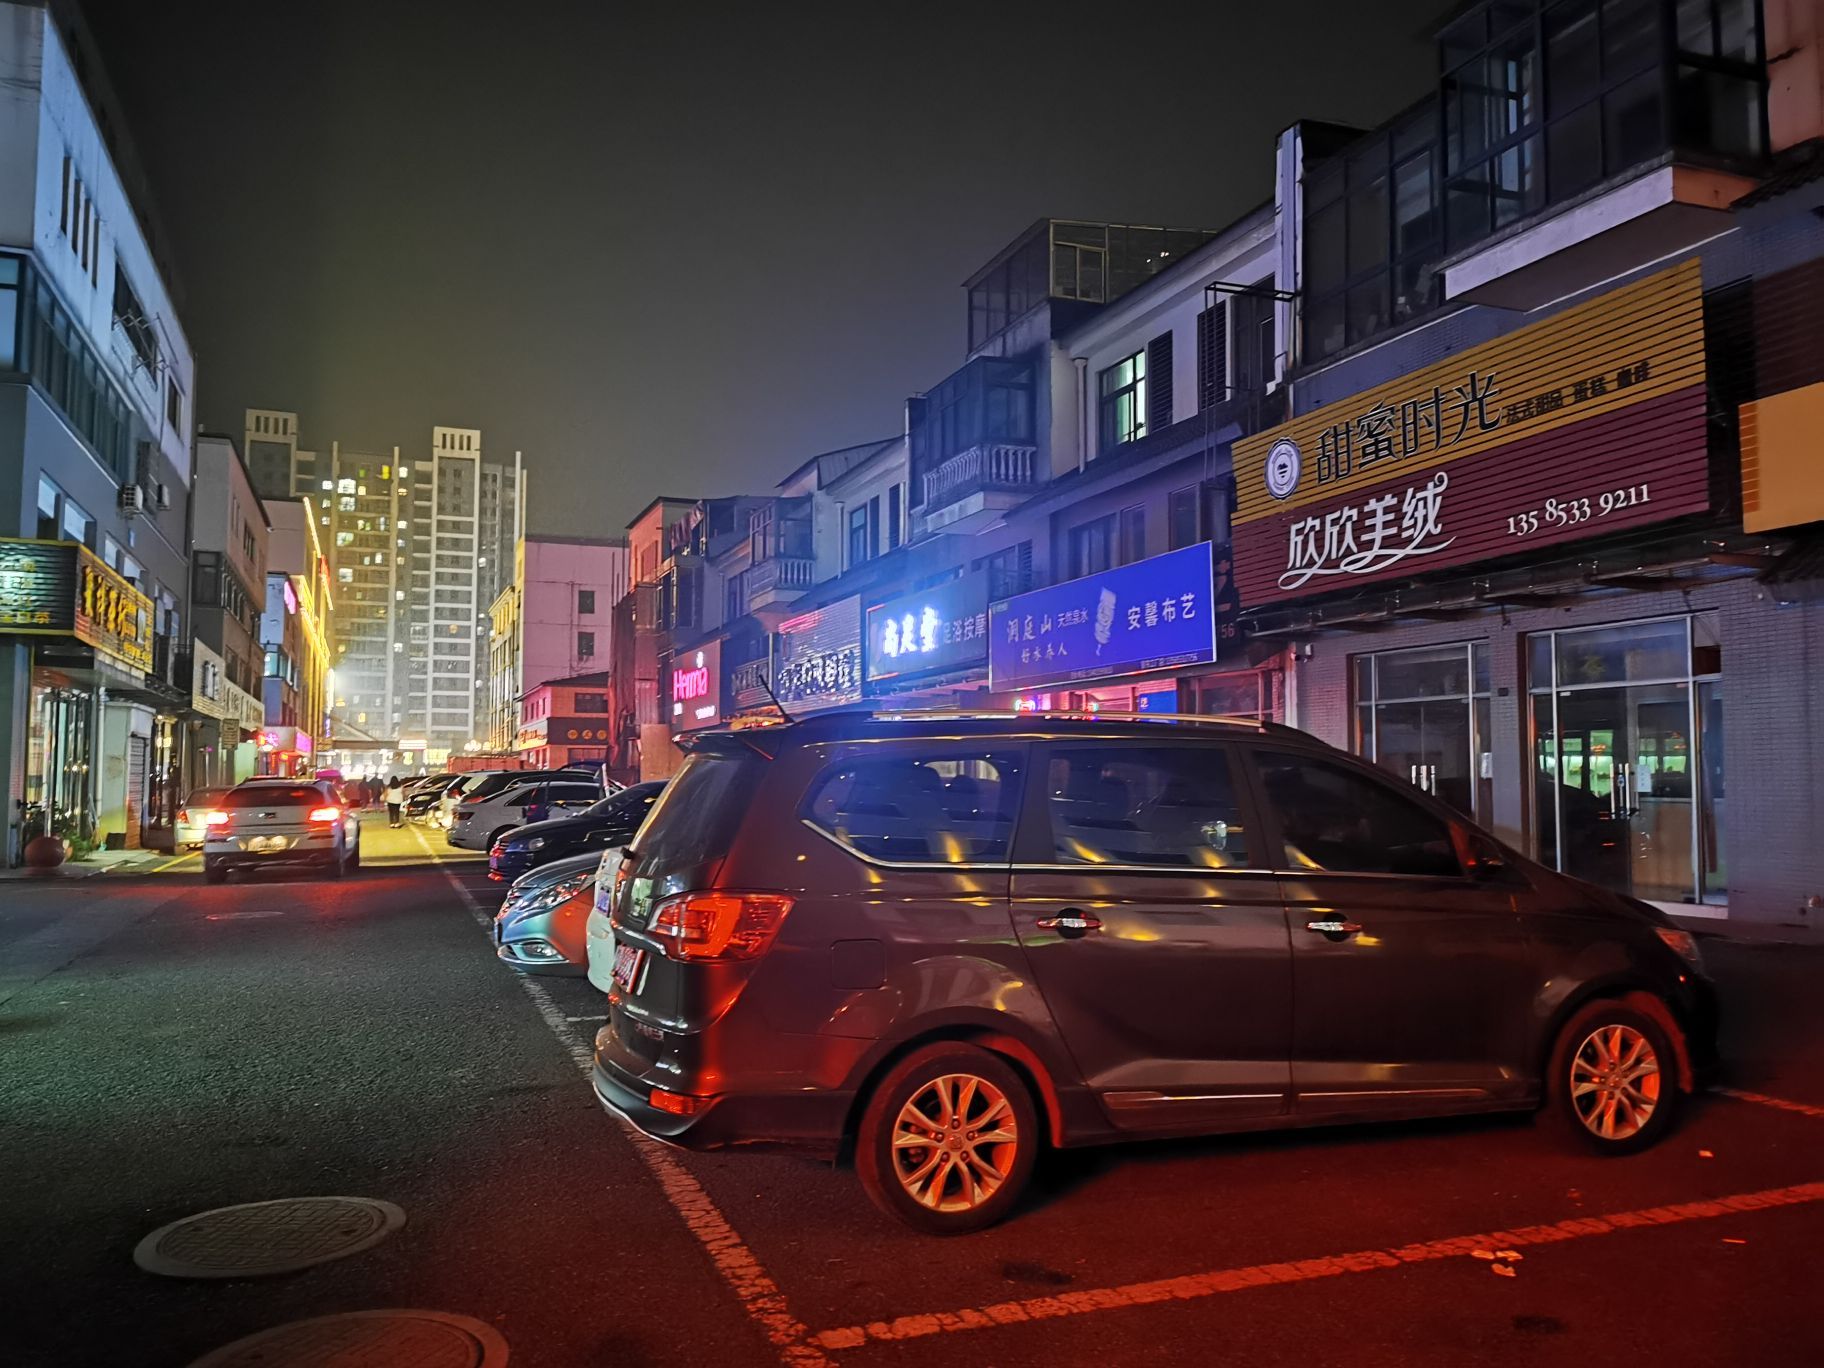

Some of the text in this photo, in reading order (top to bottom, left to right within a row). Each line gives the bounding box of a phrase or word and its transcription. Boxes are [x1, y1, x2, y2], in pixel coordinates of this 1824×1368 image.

[1316, 371, 1501, 485] 甜蜜时光
[1279, 471, 1456, 589] 欣欣羊绒
[1507, 484, 1650, 535] 135 8533 9211
[1127, 593, 1196, 631] 安馨布艺
